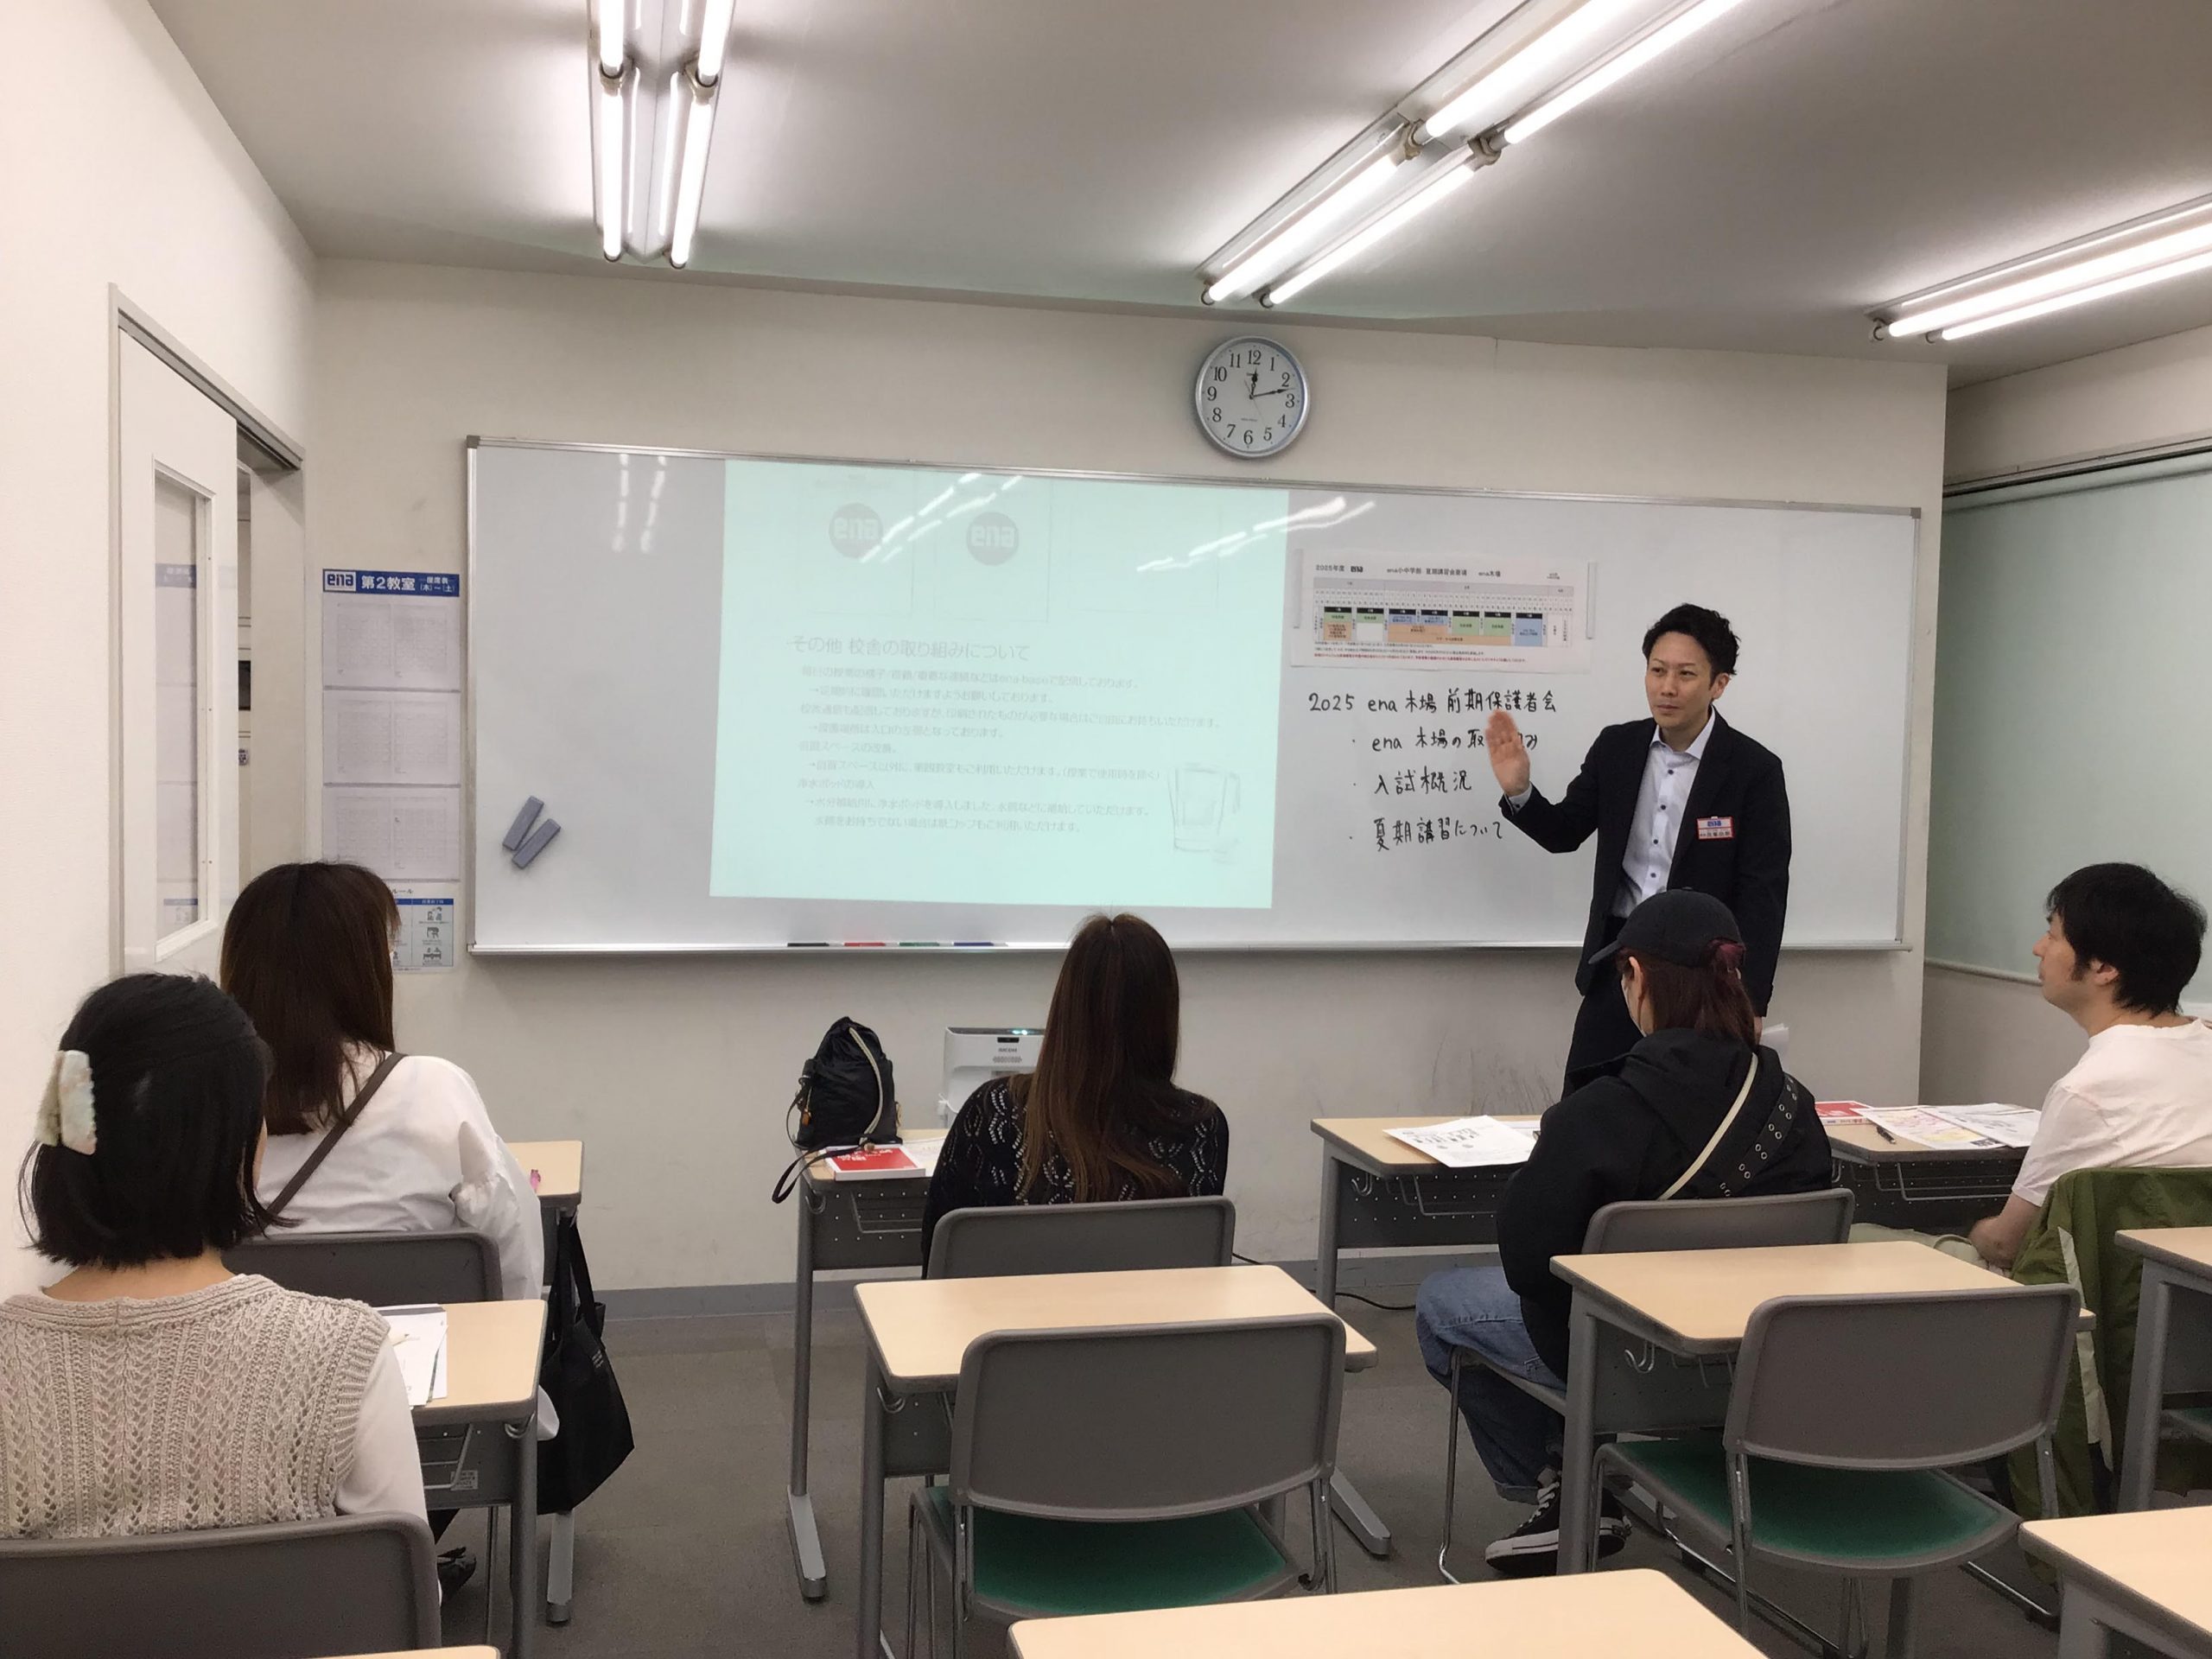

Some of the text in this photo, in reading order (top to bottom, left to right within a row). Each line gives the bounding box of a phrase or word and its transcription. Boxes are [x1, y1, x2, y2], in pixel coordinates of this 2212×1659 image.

[1230, 353, 1241, 368] 11
[1248, 350, 1262, 365] 12
[1270, 357, 1274, 371] 1
[1214, 366, 1227, 382] 10
[1281, 372, 1290, 387] 2
[1207, 386, 1217, 401] 9
[1286, 394, 1295, 408] 3
[1212, 408, 1222, 423] 8
[1278, 415, 1286, 428] 4
[1227, 424, 1236, 438] 7
[1244, 430, 1253, 445] 6
[1263, 428, 1272, 441] 5
[833, 518, 878, 540] ena
[971, 525, 1015, 548] ena
[327, 574, 416, 591] ena 第2教室
[790, 635, 1030, 661] その他 校舎の取り組みについて
[1308, 688, 1556, 714] 2025 ena 木場 前期保護者会
[1371, 726, 1538, 752] ena 木場の取み
[1374, 766, 1471, 795] 入試概況
[1374, 817, 1503, 852] 夏期講習について
